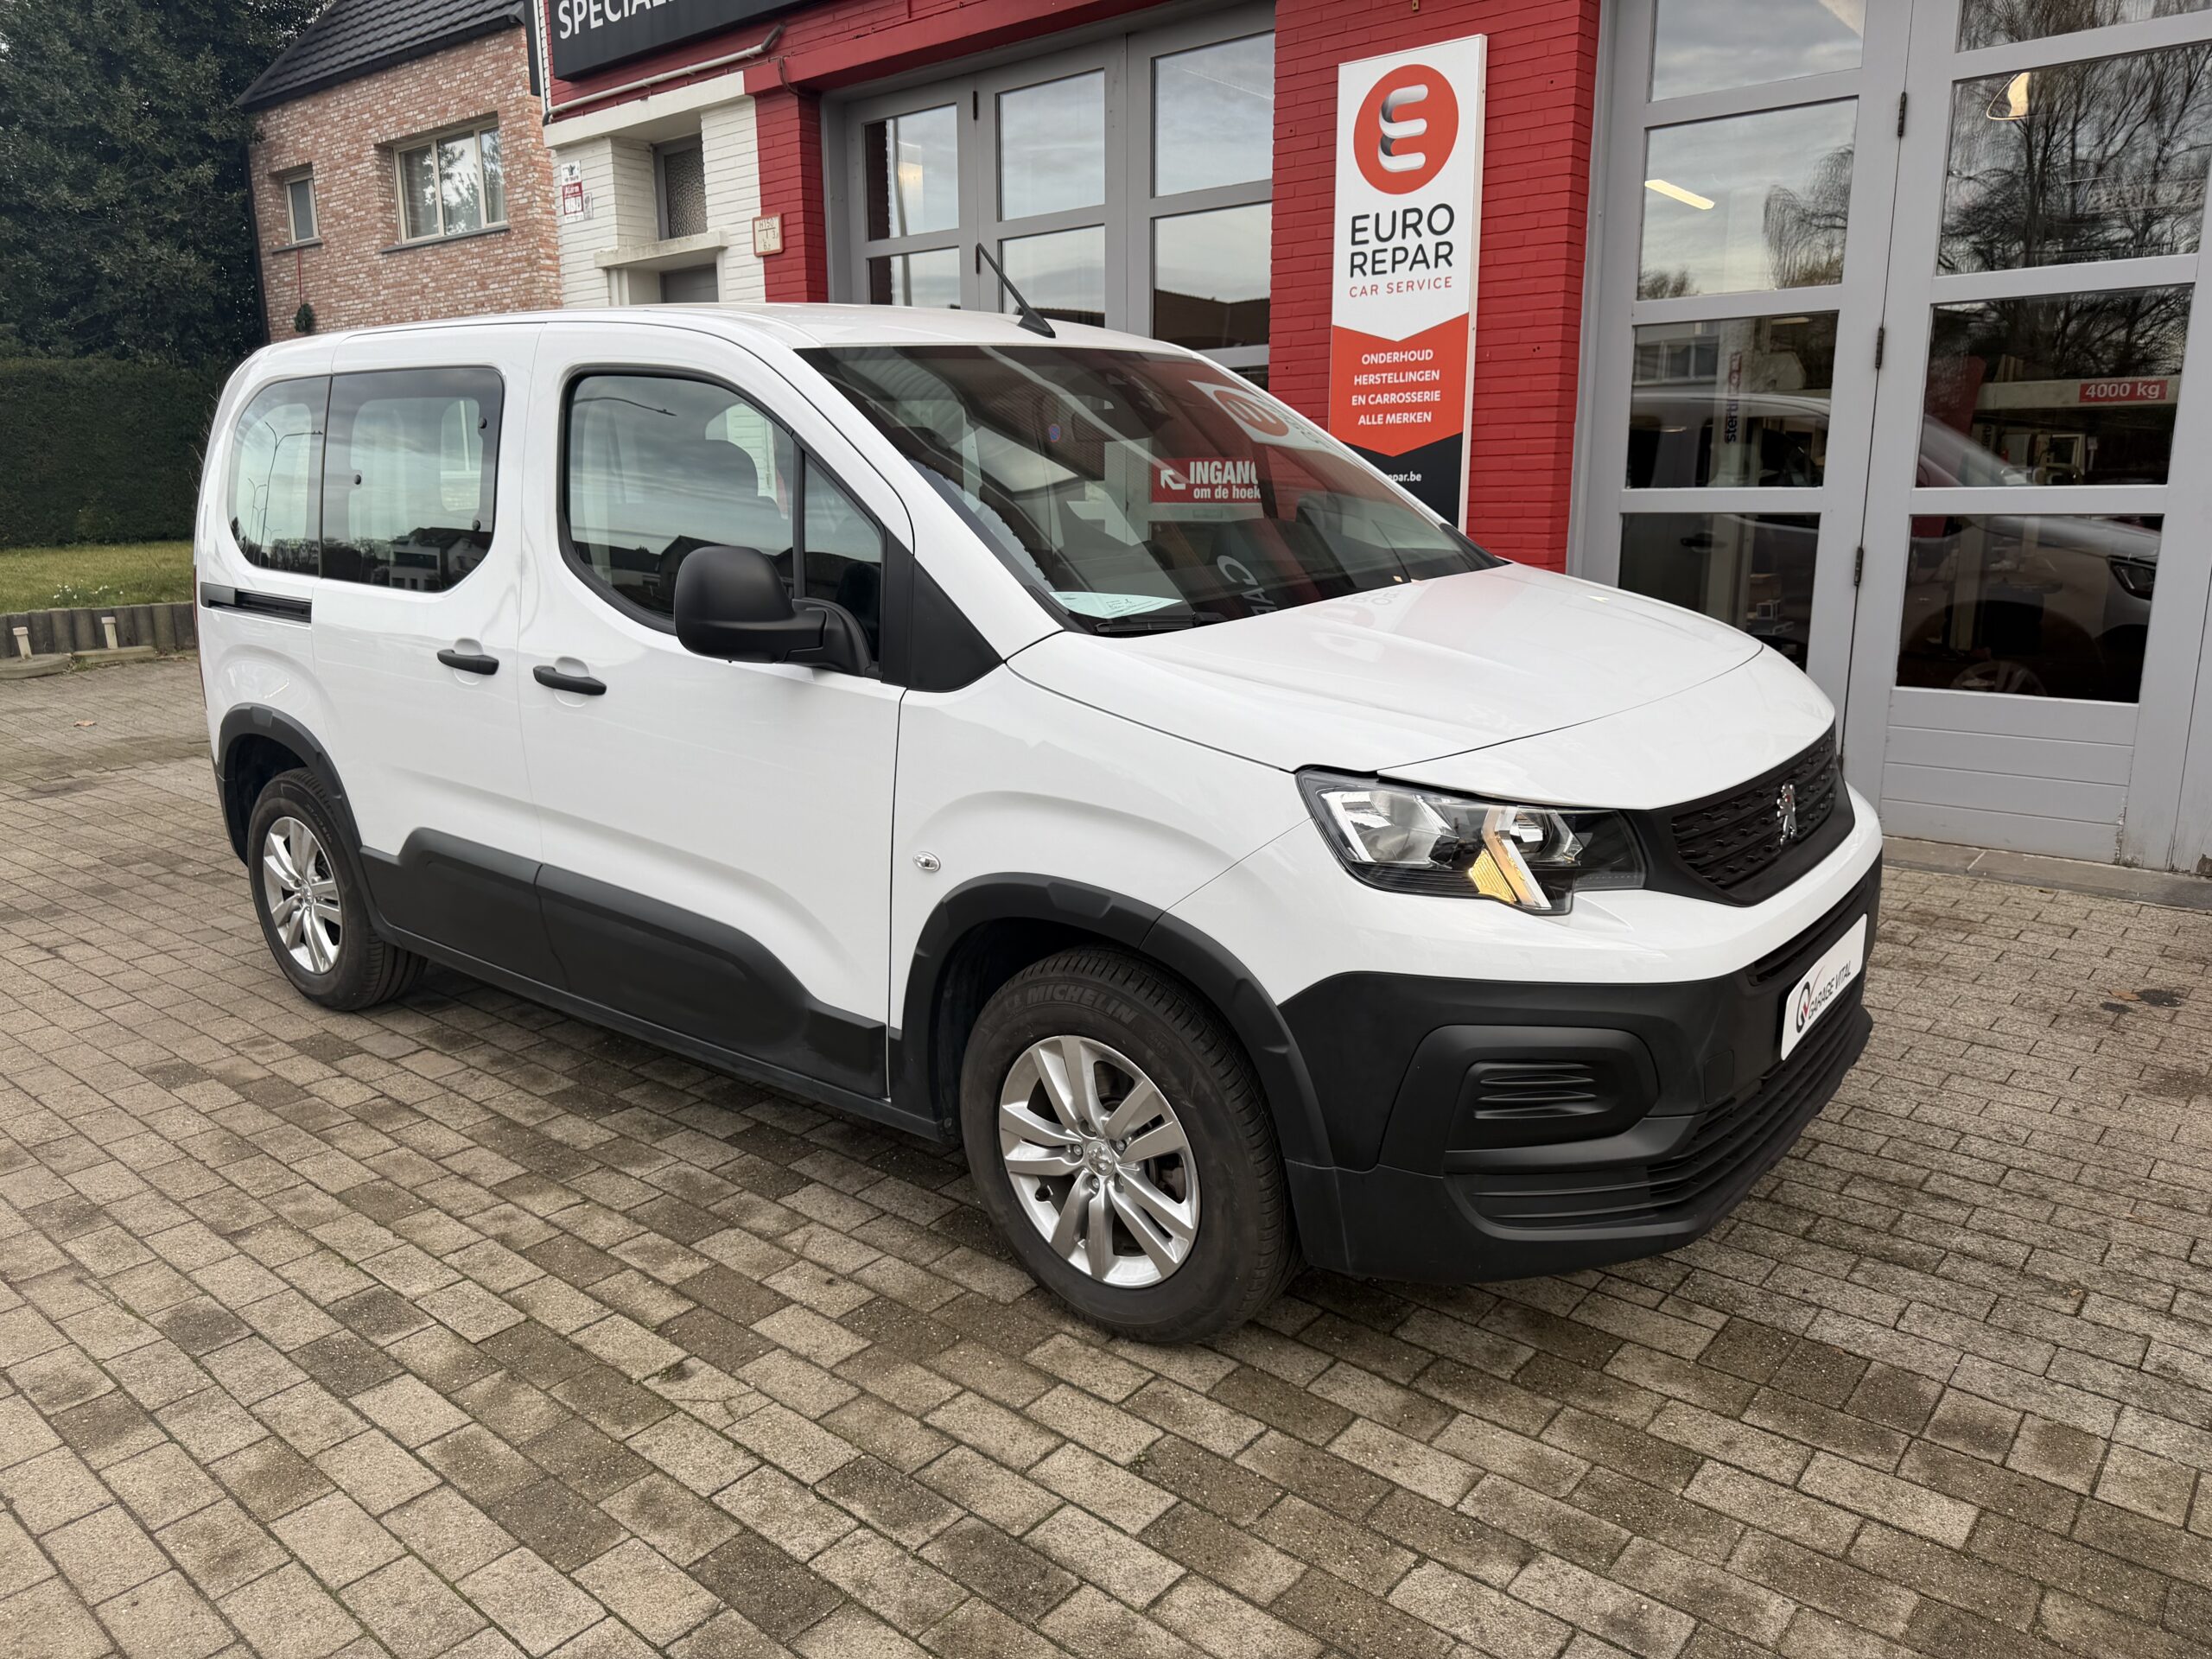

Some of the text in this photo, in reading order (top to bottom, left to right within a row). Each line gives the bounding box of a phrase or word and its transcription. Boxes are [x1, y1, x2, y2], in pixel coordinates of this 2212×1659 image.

[558, 0, 675, 40] SPECI
[1351, 203, 1455, 246] EURO
[1350, 241, 1454, 278] REPAR
[1350, 276, 1452, 298] CAR SERVICE
[1361, 349, 1434, 365] ONDERHOUD
[1353, 369, 1440, 386] HERSTELLINGEN
[1351, 390, 1441, 406] EN CARROSSERIE
[2085, 382, 2160, 399] 4000 kg
[1357, 411, 1433, 426] ALLE MERKEN
[1193, 485, 1262, 499] om de hoek
[1027, 983, 1141, 1026] MICHELIN
[1808, 976, 1835, 1020] GARAGE
